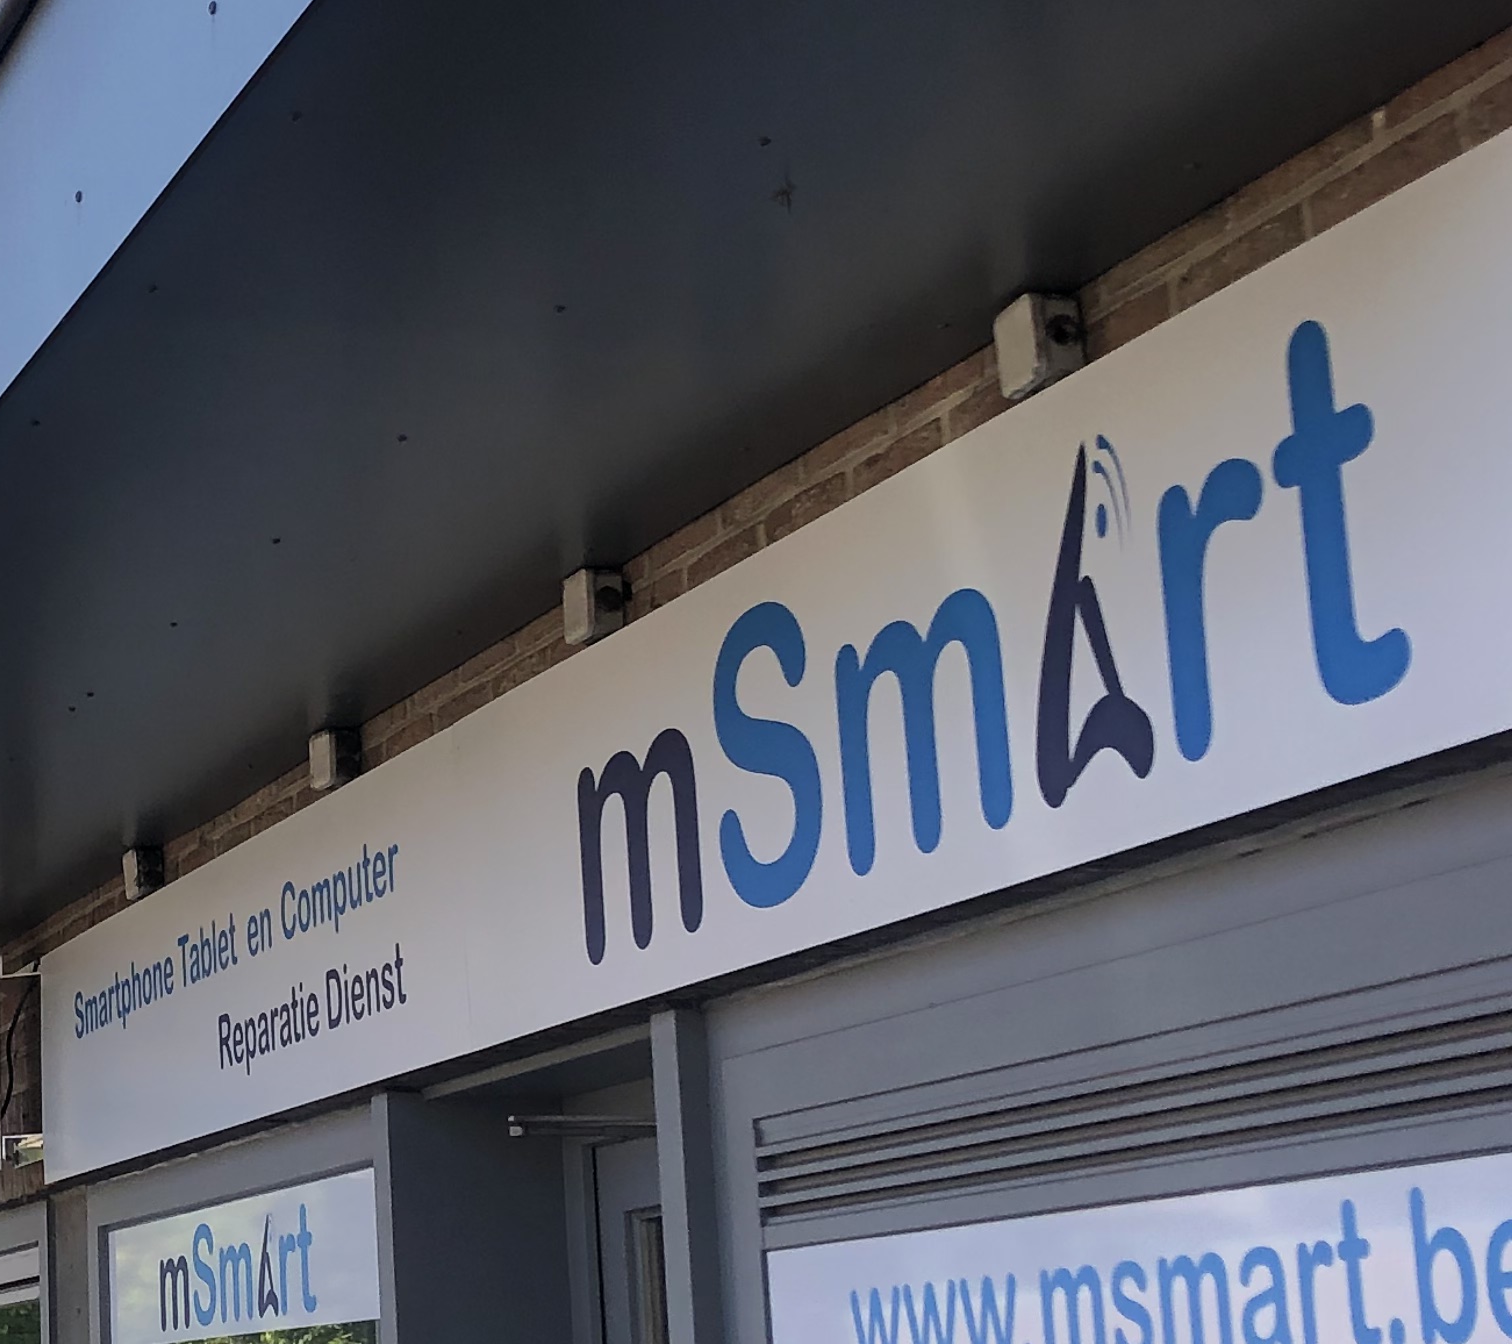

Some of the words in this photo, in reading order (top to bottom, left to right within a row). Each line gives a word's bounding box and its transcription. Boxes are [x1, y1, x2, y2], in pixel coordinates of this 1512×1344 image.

[73, 956, 174, 1039] Smartphone
[177, 912, 238, 988] Tablet
[246, 908, 273, 957] en
[280, 843, 399, 940] Computer
[218, 982, 320, 1075] Reparatie
[325, 942, 407, 1030] Dienst
